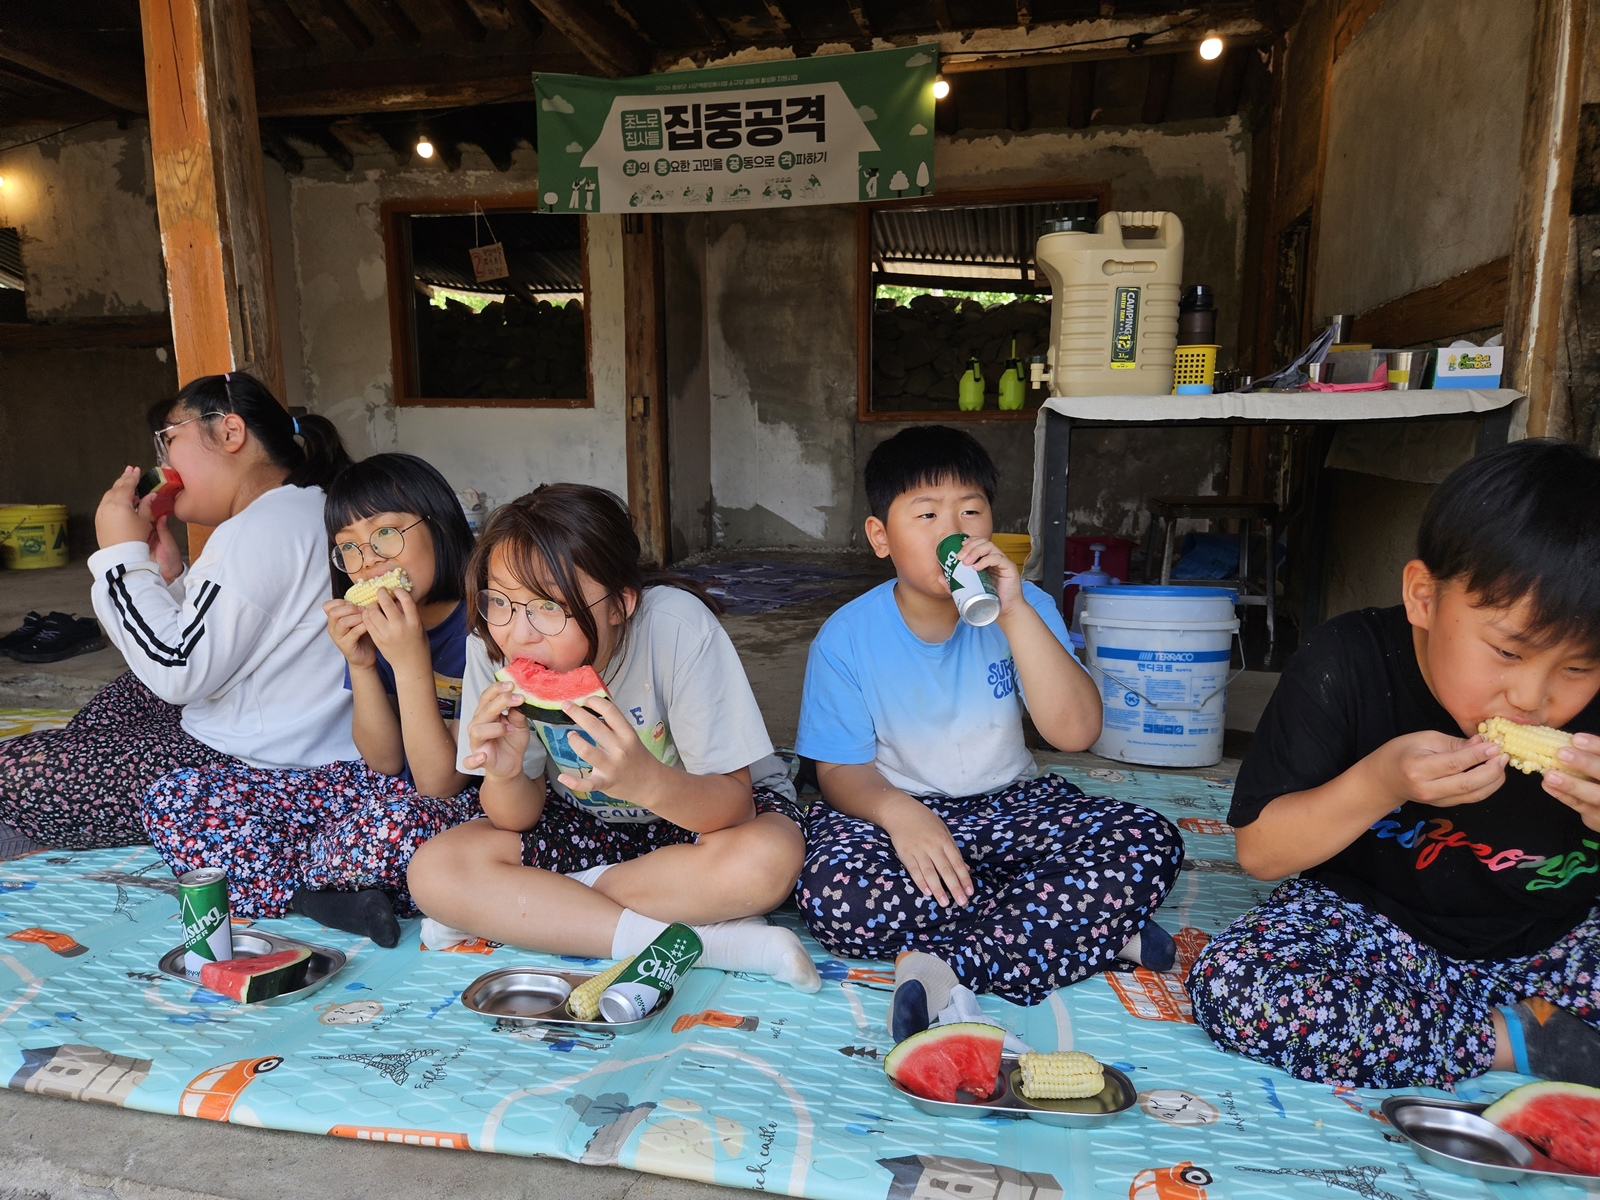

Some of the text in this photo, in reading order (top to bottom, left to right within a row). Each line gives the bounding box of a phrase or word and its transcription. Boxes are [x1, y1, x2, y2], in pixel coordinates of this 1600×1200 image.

[625, 113, 659, 129] 초느로
[664, 94, 825, 151] 집중공격
[625, 131, 660, 147] 집사들
[656, 159, 691, 175] 중요한
[693, 158, 723, 172] 고민을
[728, 154, 775, 171] 공동으로
[780, 151, 827, 168] 격파하기
[1124, 292, 1136, 335] CAMPING
[1154, 652, 1194, 662] TERRACO
[1137, 663, 1173, 673] 핸디코트
[993, 677, 1014, 700] CLU
[184, 929, 209, 949] CIDER
[637, 959, 680, 986] Chils
[659, 981, 673, 991] CID
[758, 1120, 778, 1157] castle
